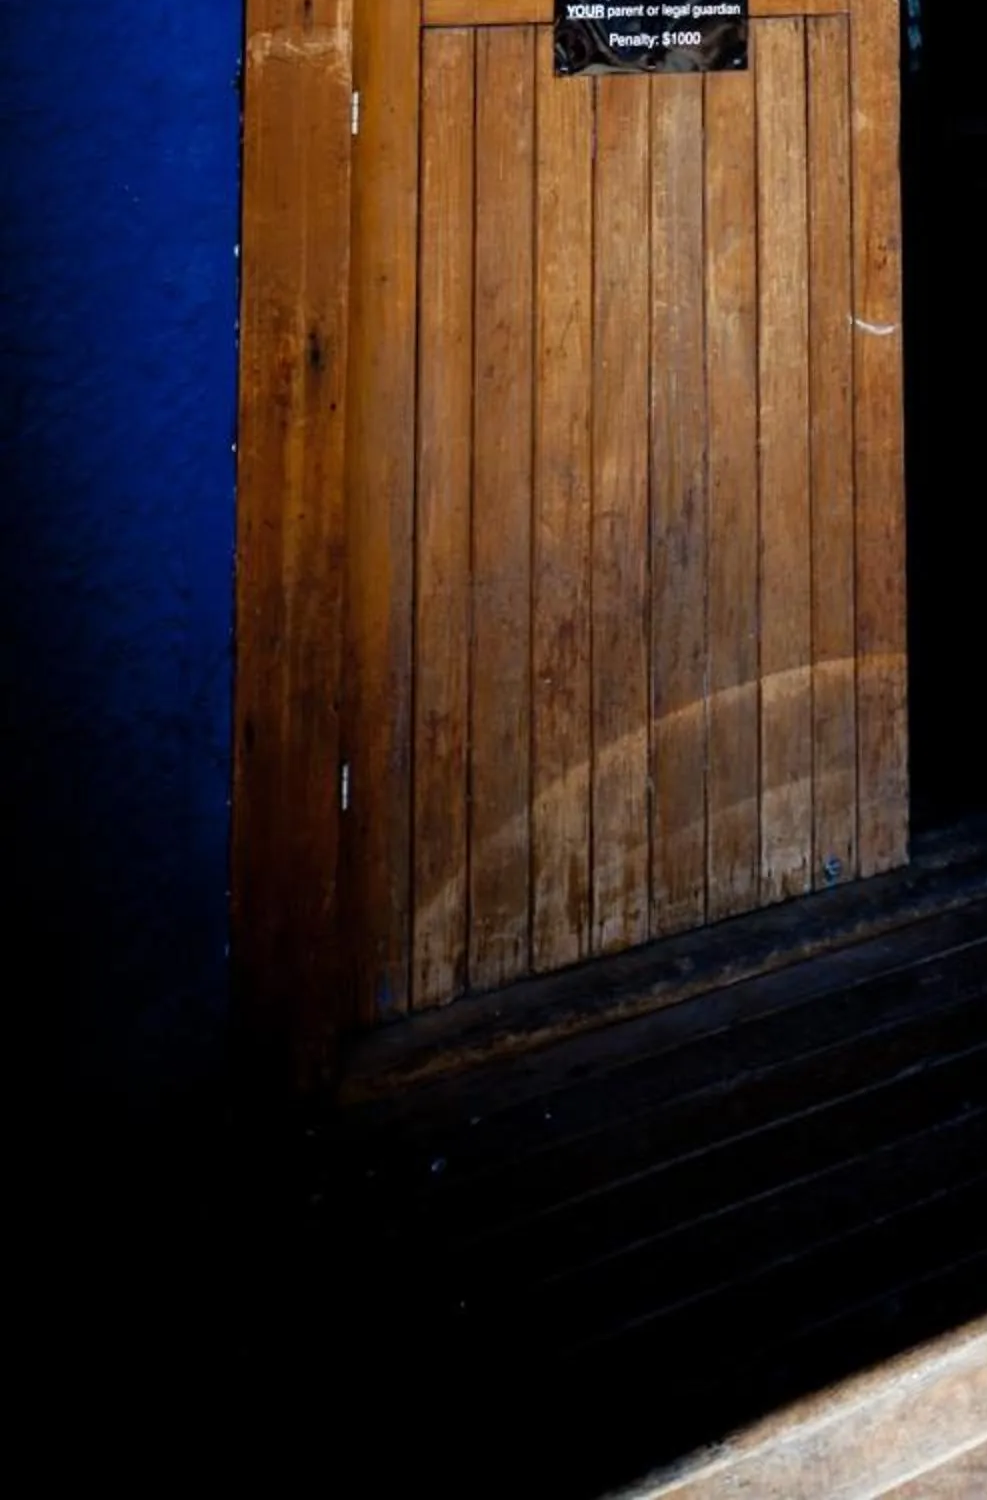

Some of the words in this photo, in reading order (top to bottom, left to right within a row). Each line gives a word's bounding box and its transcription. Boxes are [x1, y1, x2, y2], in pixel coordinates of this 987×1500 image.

[566, 5, 605, 19] YOUR
[607, 5, 644, 19] parent
[646, 6, 659, 16] or
[662, 4, 690, 19] legal
[692, 3, 741, 18] guardian
[609, 32, 659, 48] Penalty:
[661, 31, 701, 45] $1000
